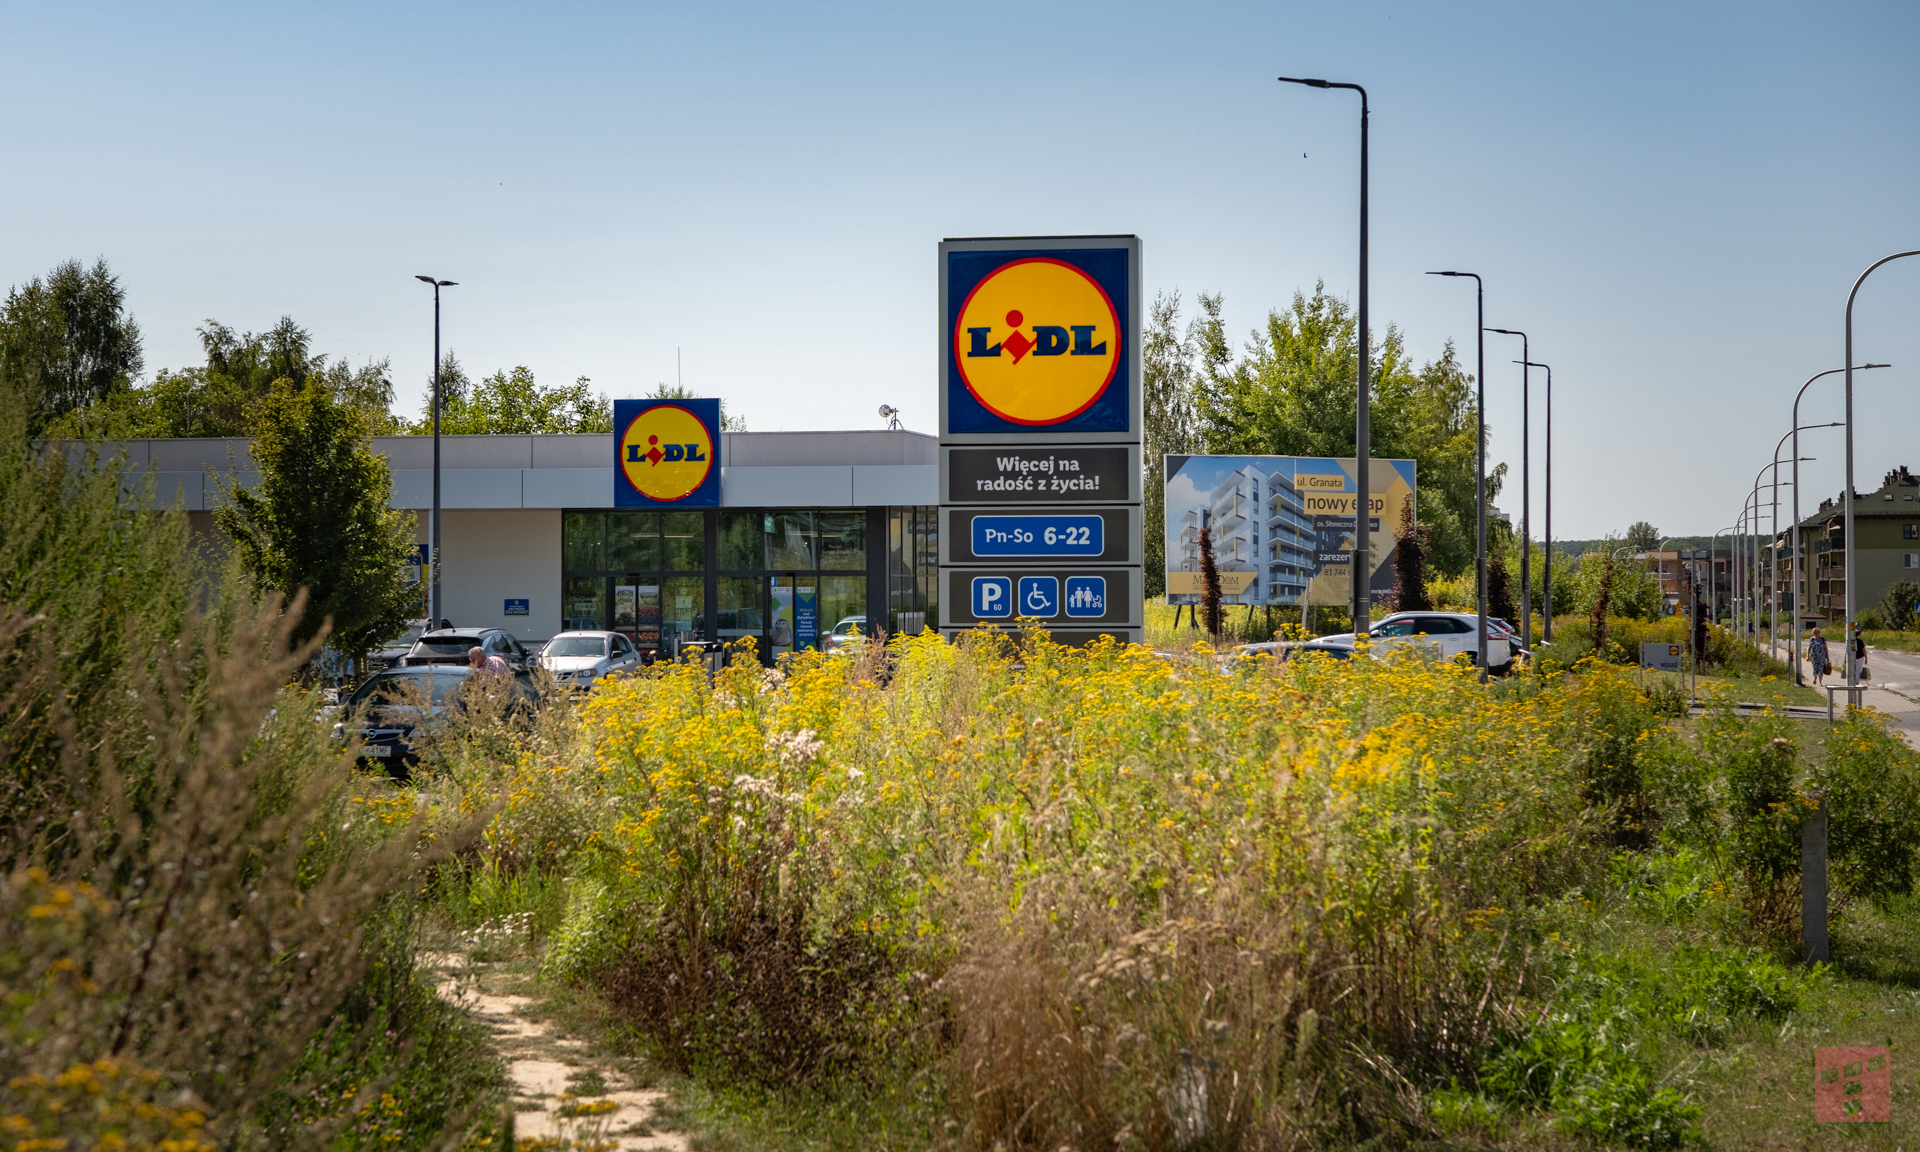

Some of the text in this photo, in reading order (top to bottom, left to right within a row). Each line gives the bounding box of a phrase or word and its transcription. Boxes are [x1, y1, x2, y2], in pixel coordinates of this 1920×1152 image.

[996, 455, 1080, 475] Więcej na
[976, 474, 1100, 494] radość z życia!
[1297, 477, 1343, 487] ul. Granata
[1307, 497, 1384, 513] nowy eap
[984, 526, 1090, 545] Pn-So 6-22
[1324, 568, 1333, 576] 81
[1334, 568, 1347, 576] 744
[981, 583, 1002, 611] P
[993, 603, 1002, 611] 60
